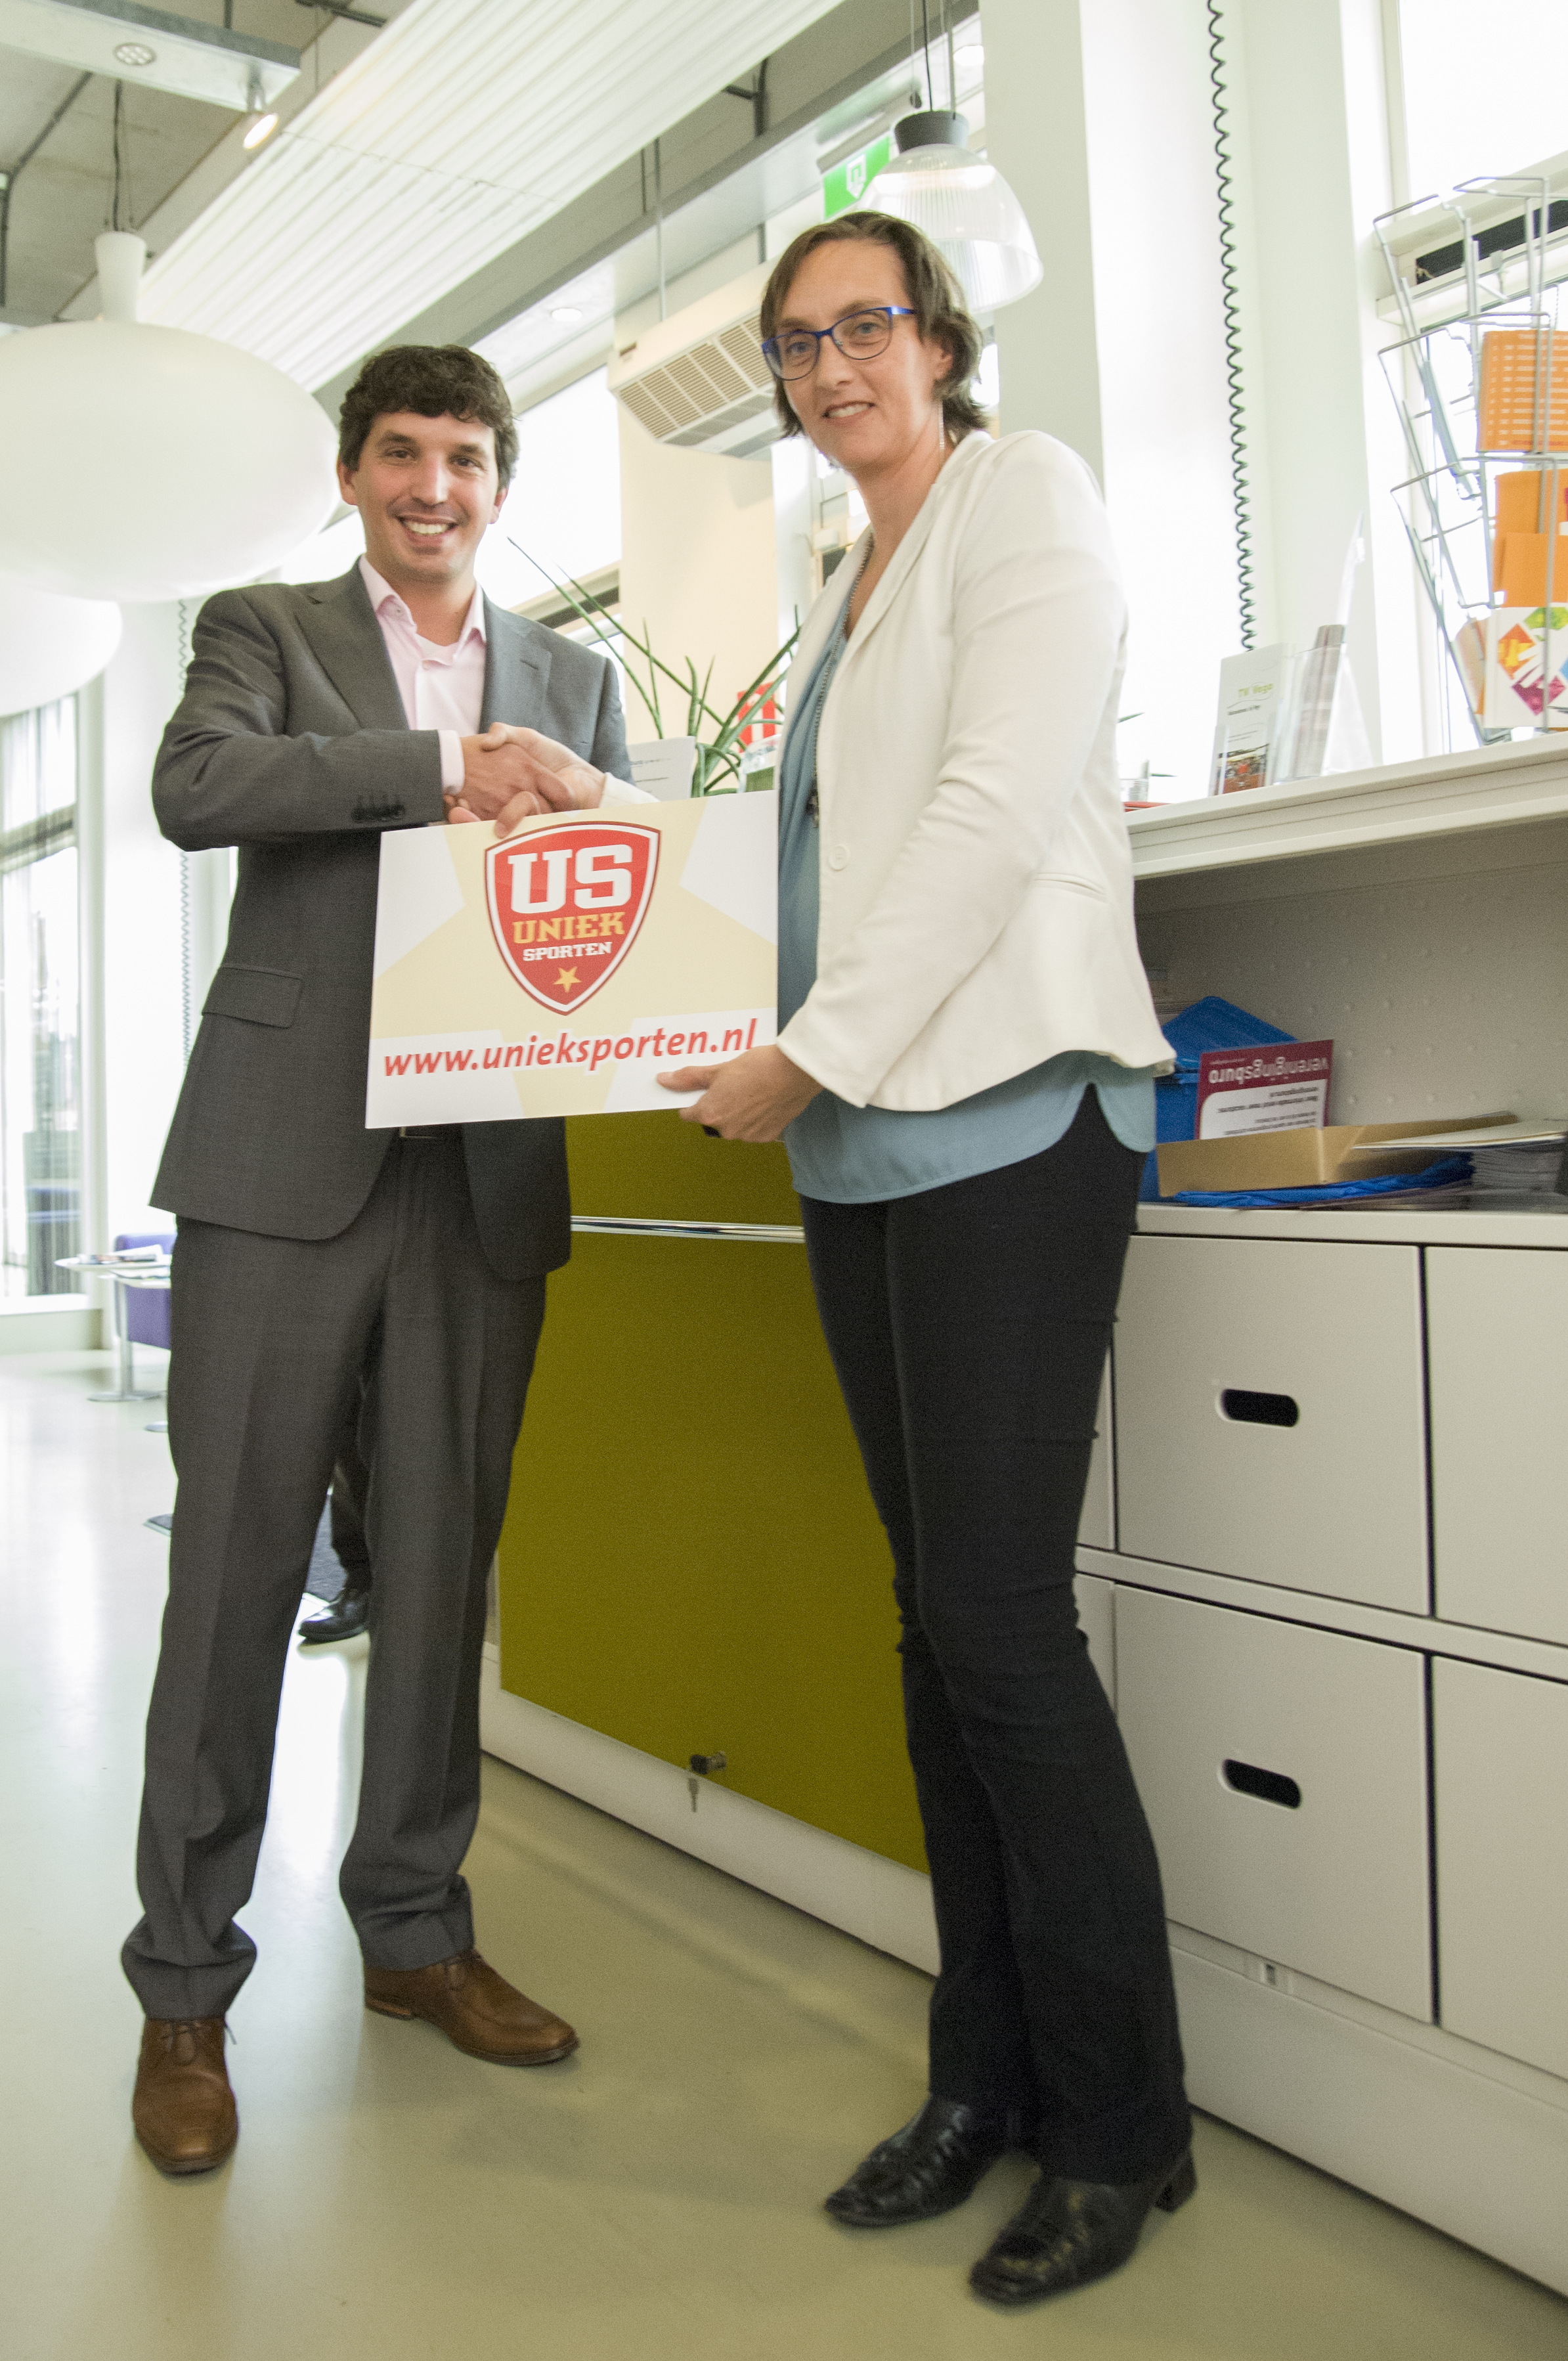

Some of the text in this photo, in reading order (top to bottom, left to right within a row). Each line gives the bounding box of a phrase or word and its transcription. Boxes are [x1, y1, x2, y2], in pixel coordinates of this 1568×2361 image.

[508, 844, 633, 914] US
[512, 912, 625, 944] UNIEK
[522, 942, 612, 961] SPORTEN
[384, 1019, 757, 1076] www.unieksporten.nl
[1209, 1057, 1328, 1084] verenigingsburo
